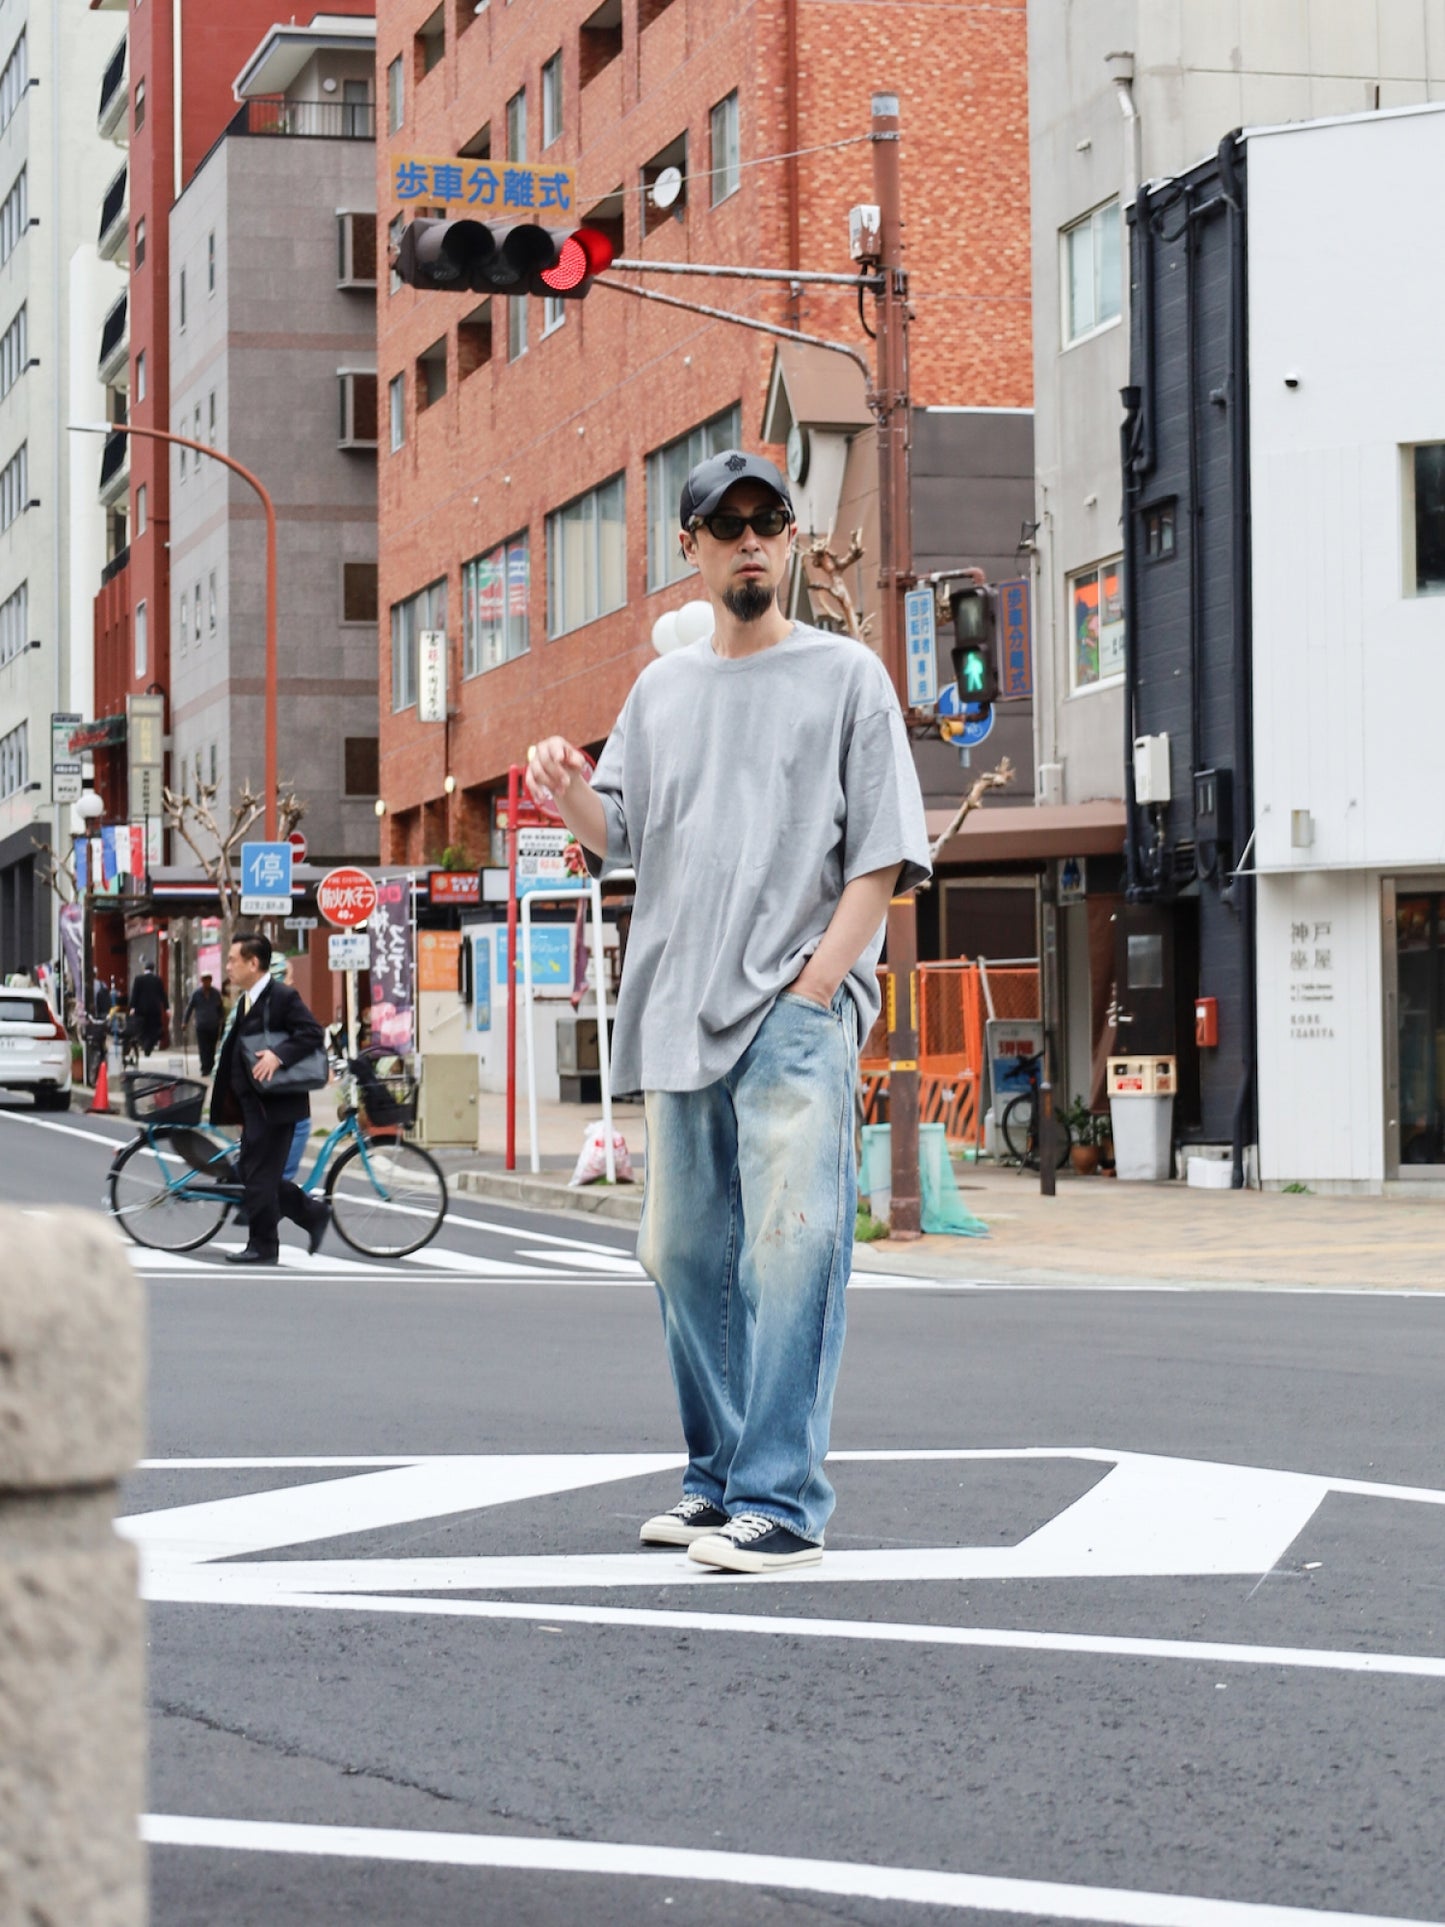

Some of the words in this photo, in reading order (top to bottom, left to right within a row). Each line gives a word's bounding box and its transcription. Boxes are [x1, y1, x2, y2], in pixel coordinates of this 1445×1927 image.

[396, 160, 570, 211] 歩車分離式
[250, 852, 284, 888] 停
[322, 886, 375, 909] 防火水そう
[1290, 921, 1332, 943] 神戸
